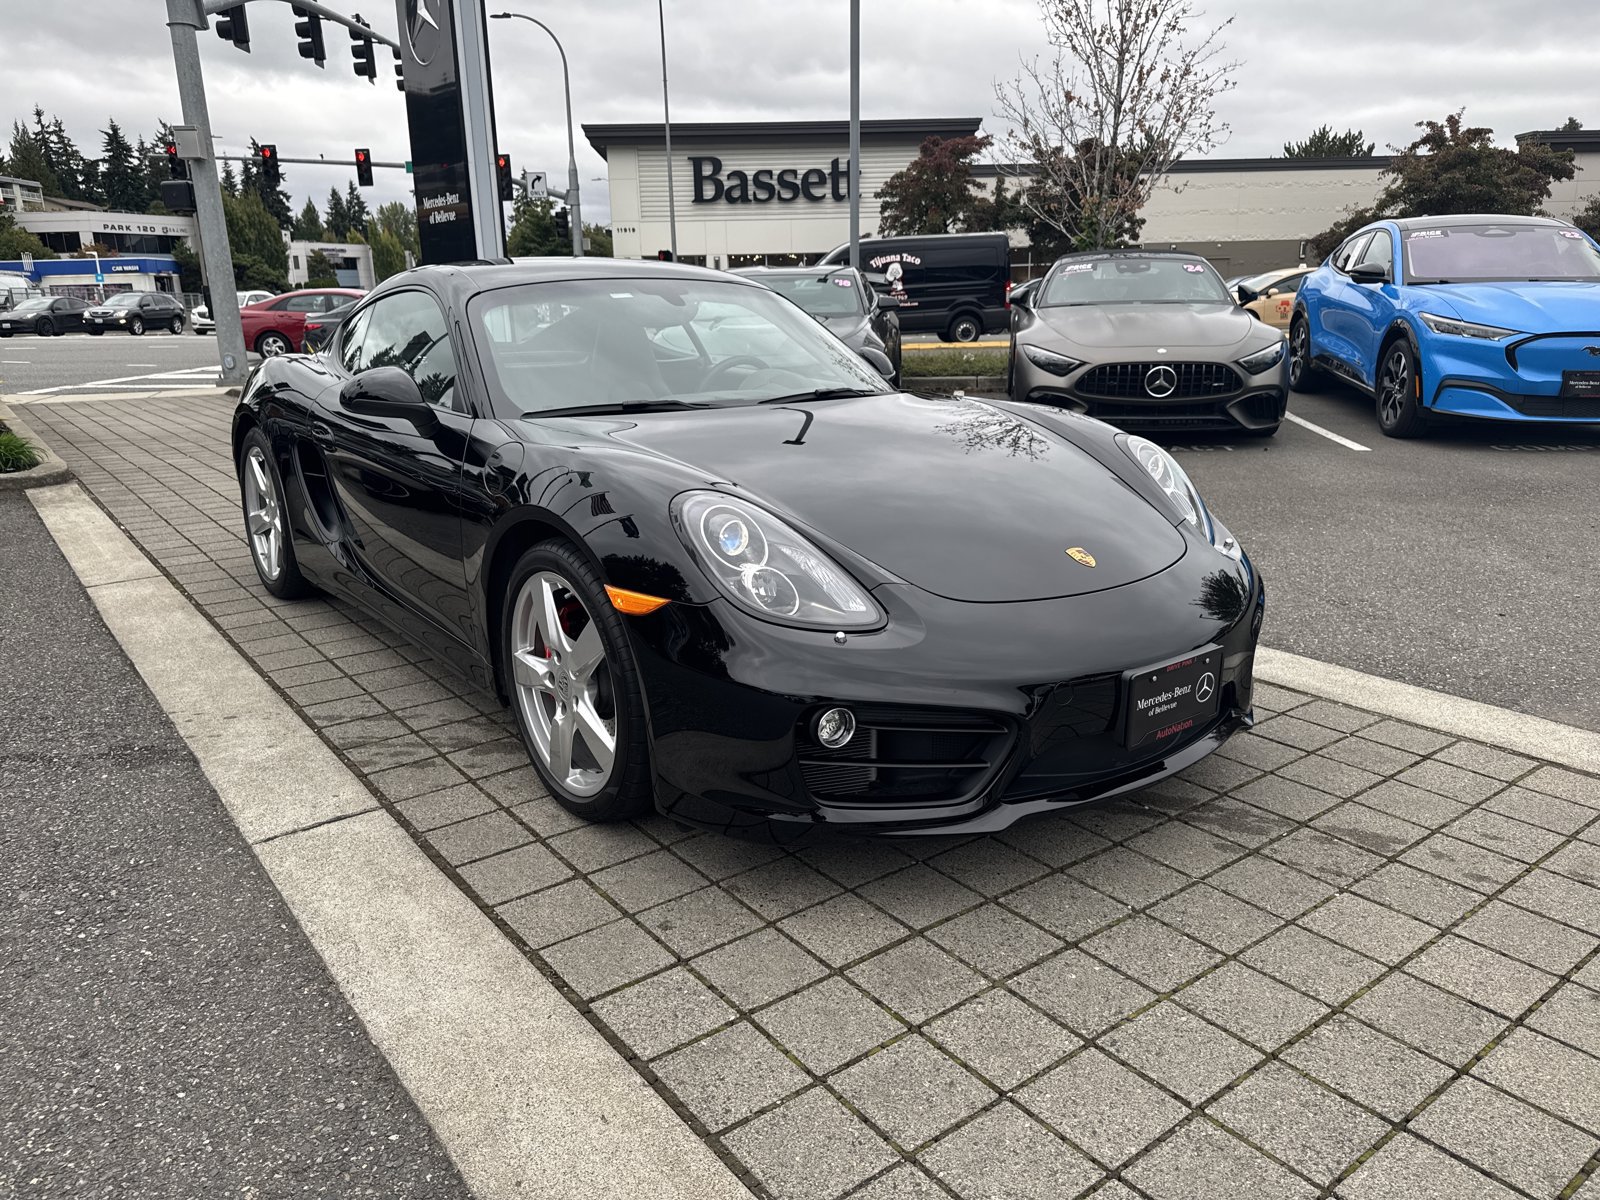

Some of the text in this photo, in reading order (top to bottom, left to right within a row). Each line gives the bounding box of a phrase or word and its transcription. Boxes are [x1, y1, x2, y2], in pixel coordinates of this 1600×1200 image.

[423, 192, 459, 210] Mercedes-Benz
[429, 210, 456, 224] of Bellevue
[103, 223, 156, 233] PARK 120
[870, 253, 921, 268] Tijuana Taco
[1137, 684, 1192, 711] Mercedes-Benz
[1148, 701, 1178, 717] of Bellevue
[1156, 719, 1193, 740] AutoNation
